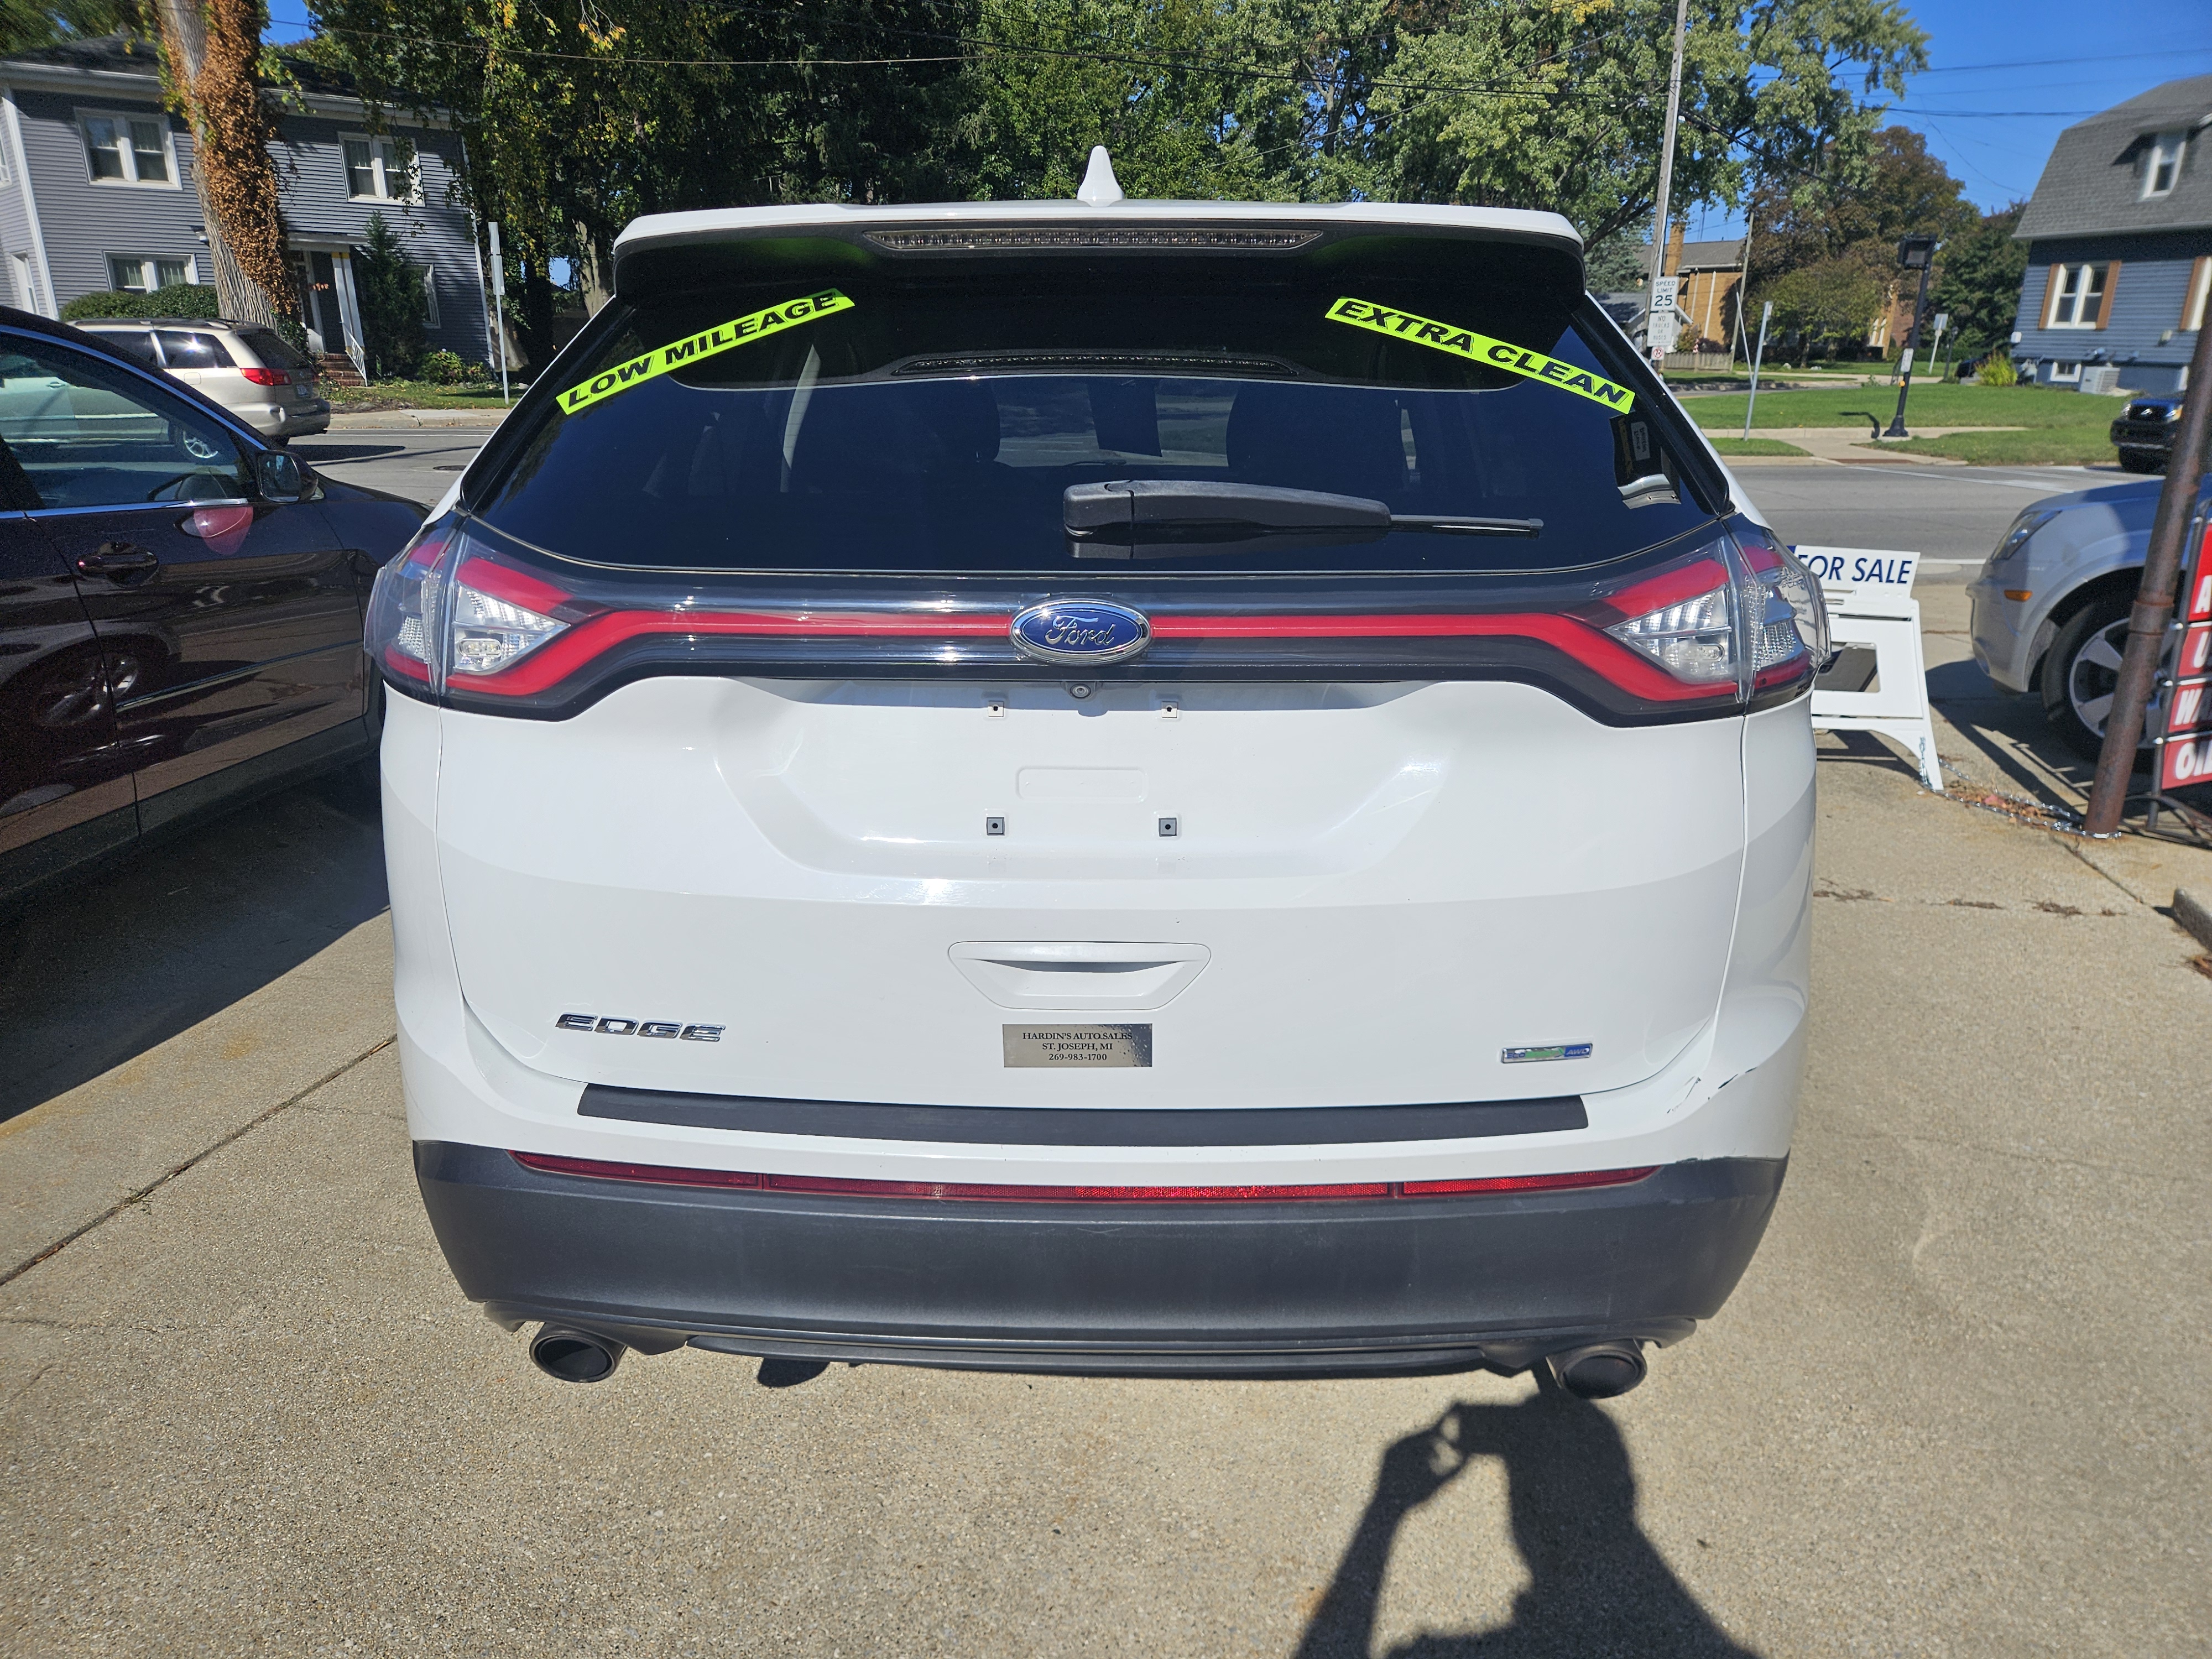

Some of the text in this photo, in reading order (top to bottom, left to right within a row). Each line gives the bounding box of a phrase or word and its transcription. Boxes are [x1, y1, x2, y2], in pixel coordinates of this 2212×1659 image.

[1655, 295, 1673, 306] 25
[567, 292, 839, 408] LOW MILEAGE
[1335, 300, 1629, 406] EXTRA CLEAN
[1851, 558, 1912, 584] SALE
[1045, 615, 1116, 646] Ford
[555, 1011, 726, 1042] EDGE
[1057, 1043, 1098, 1052] JOSEPH,
[1566, 1047, 1589, 1056] AWD
